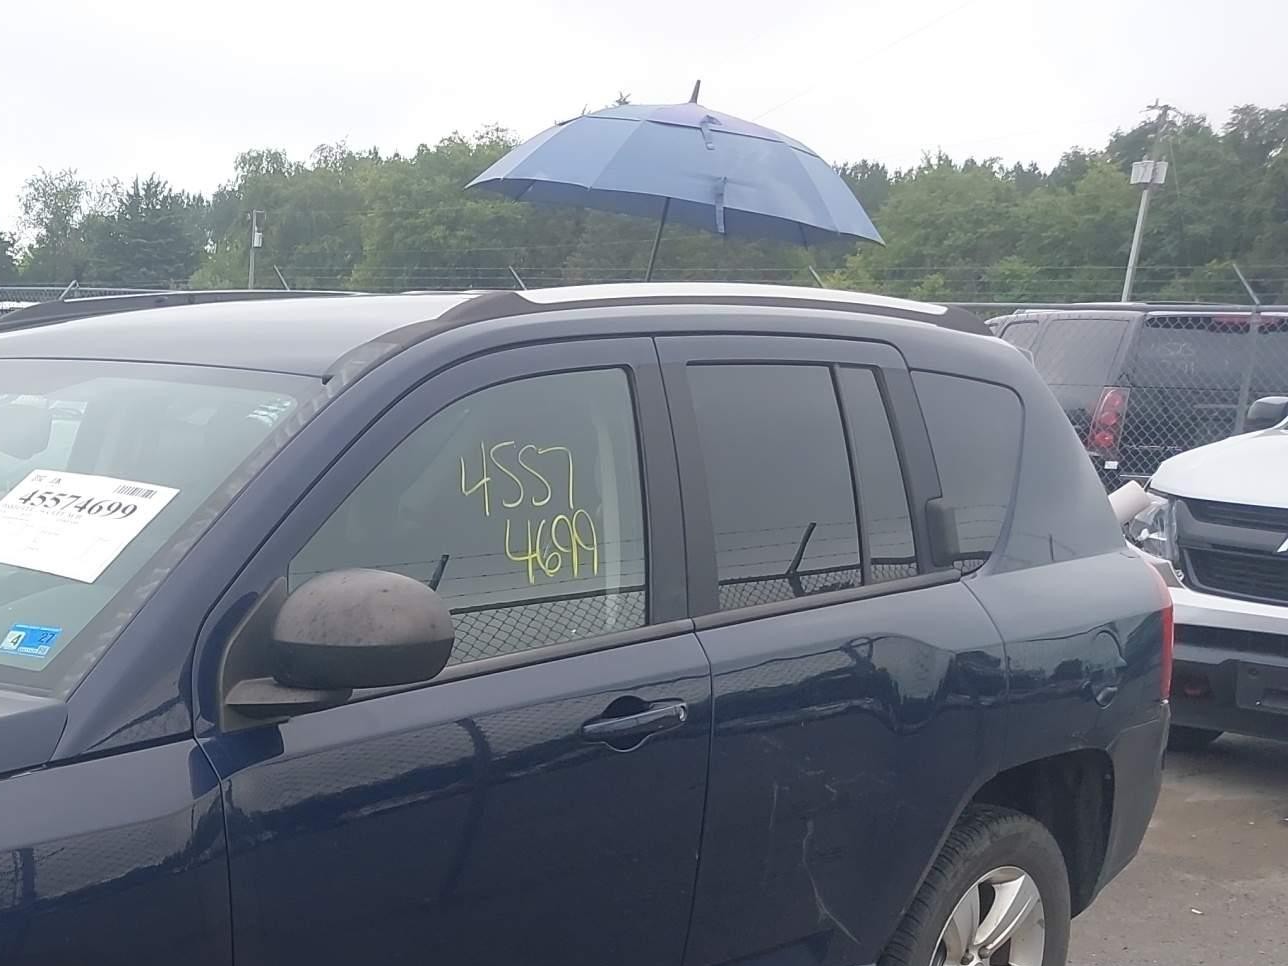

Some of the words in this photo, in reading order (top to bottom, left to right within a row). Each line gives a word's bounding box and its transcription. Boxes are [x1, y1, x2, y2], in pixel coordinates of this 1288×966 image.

[461, 440, 575, 517] 4557
[19, 489, 138, 519] 45574699
[506, 508, 599, 584] 4699
[9, 633, 23, 646] 4
[38, 631, 57, 644] 27
